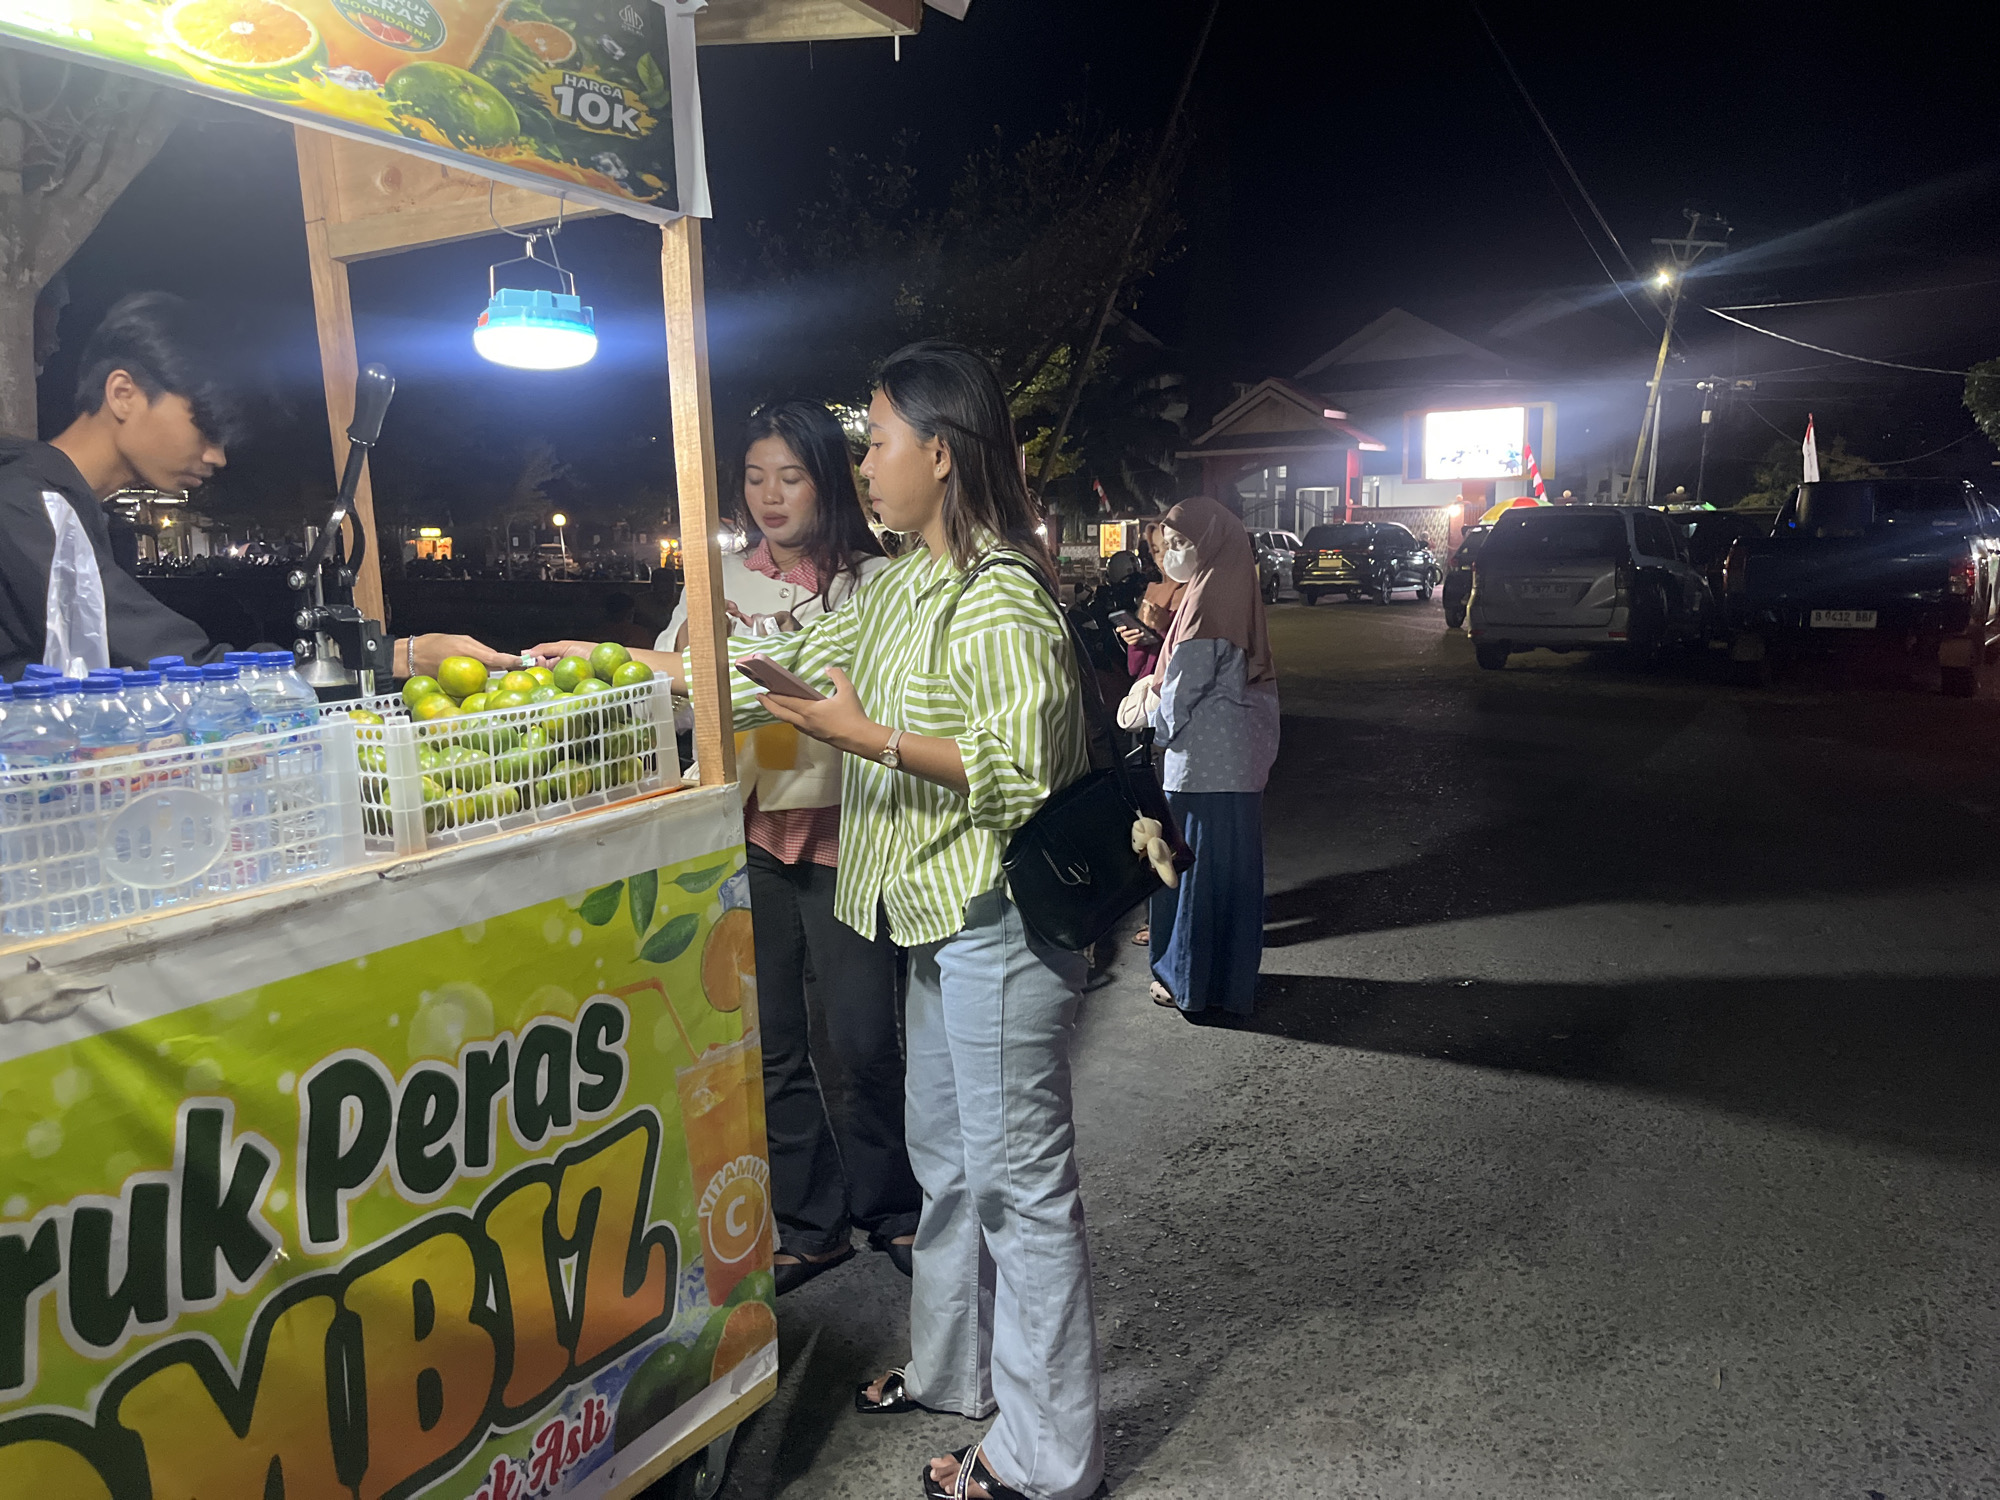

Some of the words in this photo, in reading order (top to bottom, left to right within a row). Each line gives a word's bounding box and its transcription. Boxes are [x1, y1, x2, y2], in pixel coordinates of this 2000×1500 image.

[553, 85, 640, 132] 10K
[564, 73, 623, 100] HARGA
[303, 999, 629, 1245] Peras
[697, 1154, 771, 1218] VITAMIN
[725, 1194, 748, 1238] C
[0, 1110, 679, 1500] MBIZ
[529, 1396, 612, 1491] Asli
